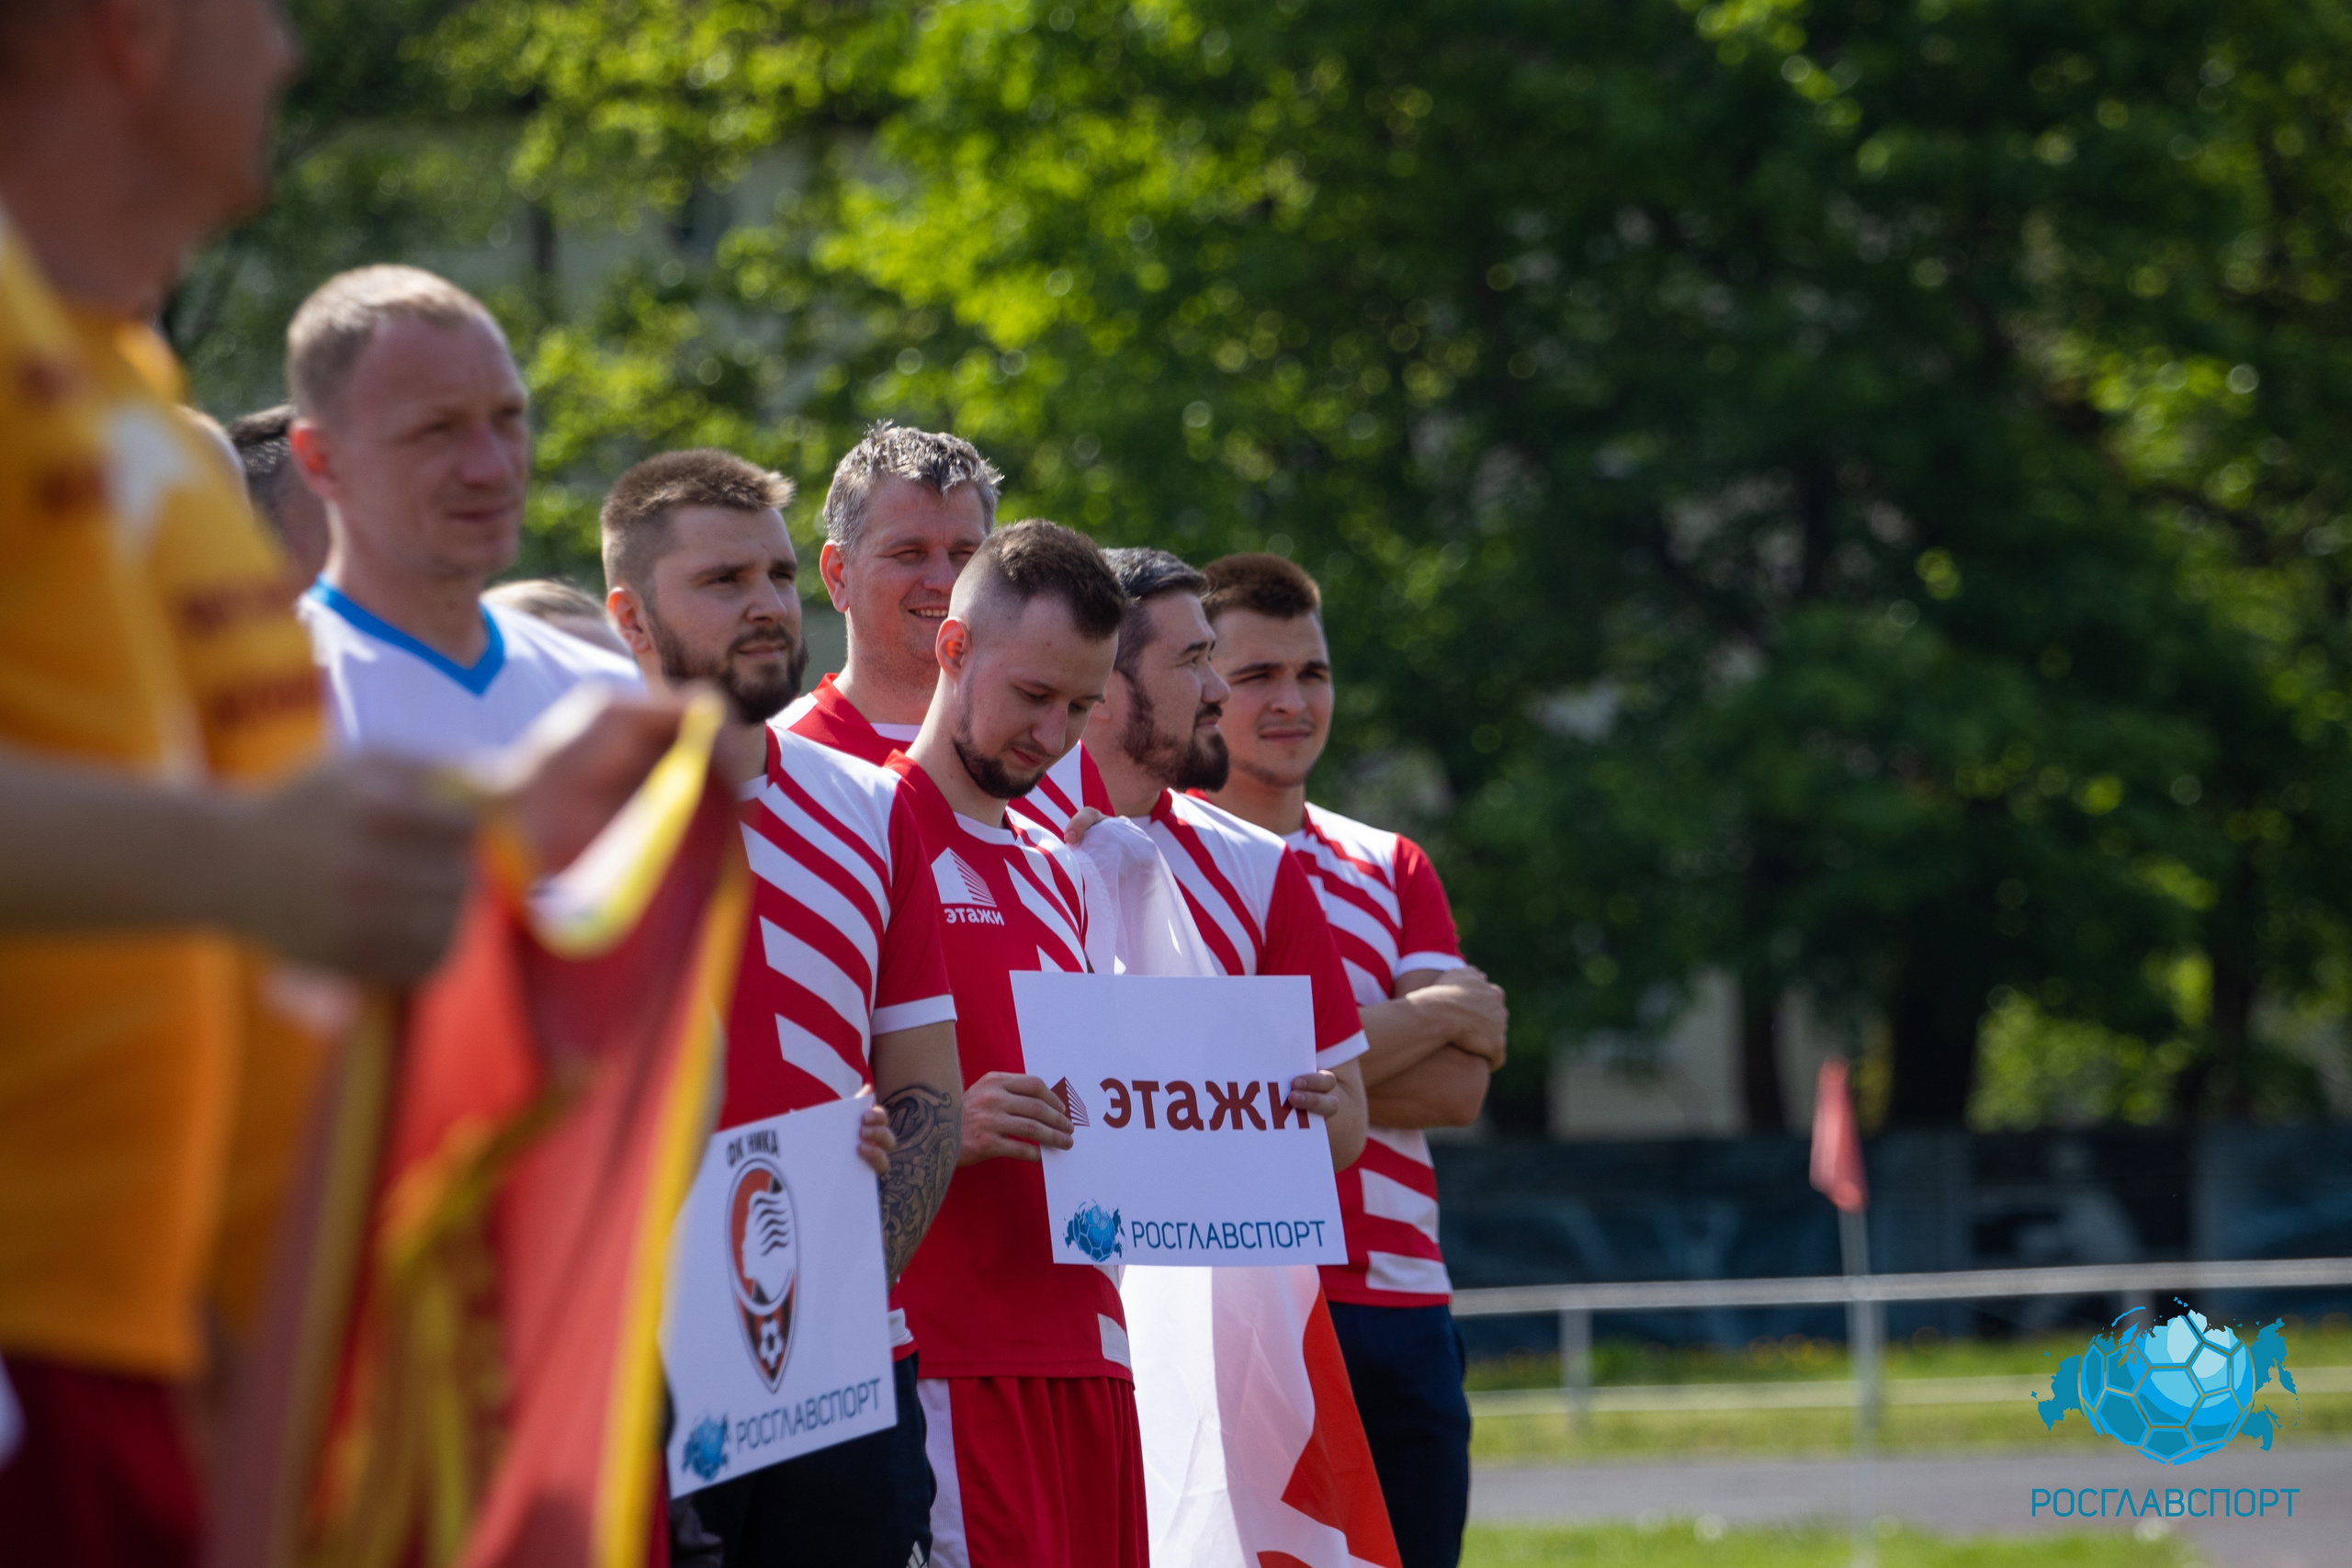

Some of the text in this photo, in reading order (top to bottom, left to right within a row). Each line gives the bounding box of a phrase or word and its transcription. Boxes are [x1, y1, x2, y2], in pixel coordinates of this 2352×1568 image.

[944, 908, 1005, 926] этажи
[1100, 1077, 1310, 1131] этажи
[746, 1130, 779, 1157] НИКА
[1131, 1220, 1325, 1249] РОСГЛАВСПОРТ
[736, 1379, 880, 1454] РОСГЛАВСПОРТ
